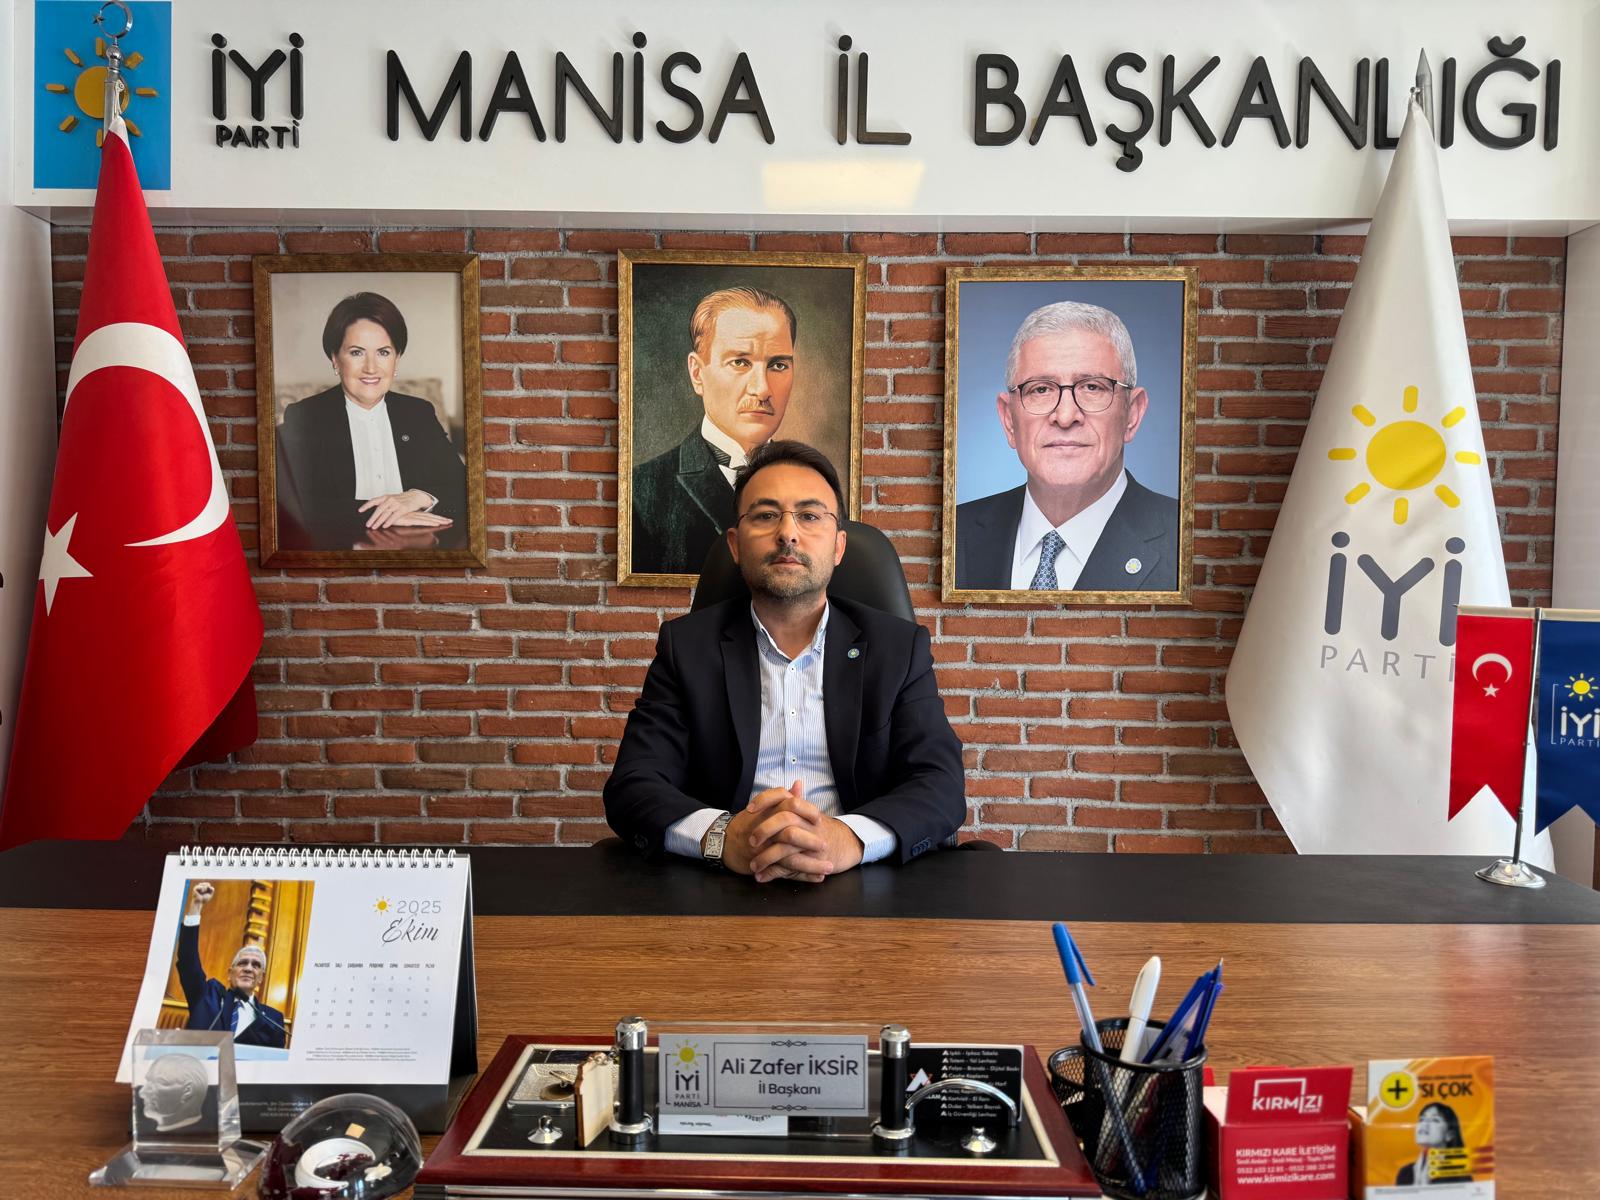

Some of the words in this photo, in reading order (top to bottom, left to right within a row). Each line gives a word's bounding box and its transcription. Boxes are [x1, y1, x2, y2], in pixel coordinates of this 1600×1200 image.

[212, 32, 305, 121] İYİ
[386, 31, 776, 145] MANİSA
[838, 34, 912, 146] İL
[975, 35, 1561, 173] BAŞKANLIĞI
[215, 120, 300, 149] PARTİ
[1324, 531, 1466, 647] İYİ
[1320, 645, 1455, 683] PARTİ
[396, 900, 442, 915] 2025
[382, 914, 440, 946] Ekim
[721, 1058, 744, 1075] Ali
[750, 1058, 804, 1075] Zafer
[809, 1055, 858, 1076] İKSİR
[675, 1070, 700, 1091] İYİ
[758, 1080, 766, 1094] İl
[769, 1083, 821, 1097] Başkanı
[1437, 1081, 1473, 1099] ÇOK
[673, 1100, 702, 1108] MANİSA
[1252, 1095, 1323, 1113] KIRMIZI
[1236, 1148, 1270, 1157] KIRMIZI
[1273, 1147, 1297, 1156] KARE
[1237, 1173, 1336, 1184] www.kirmizikare.com
